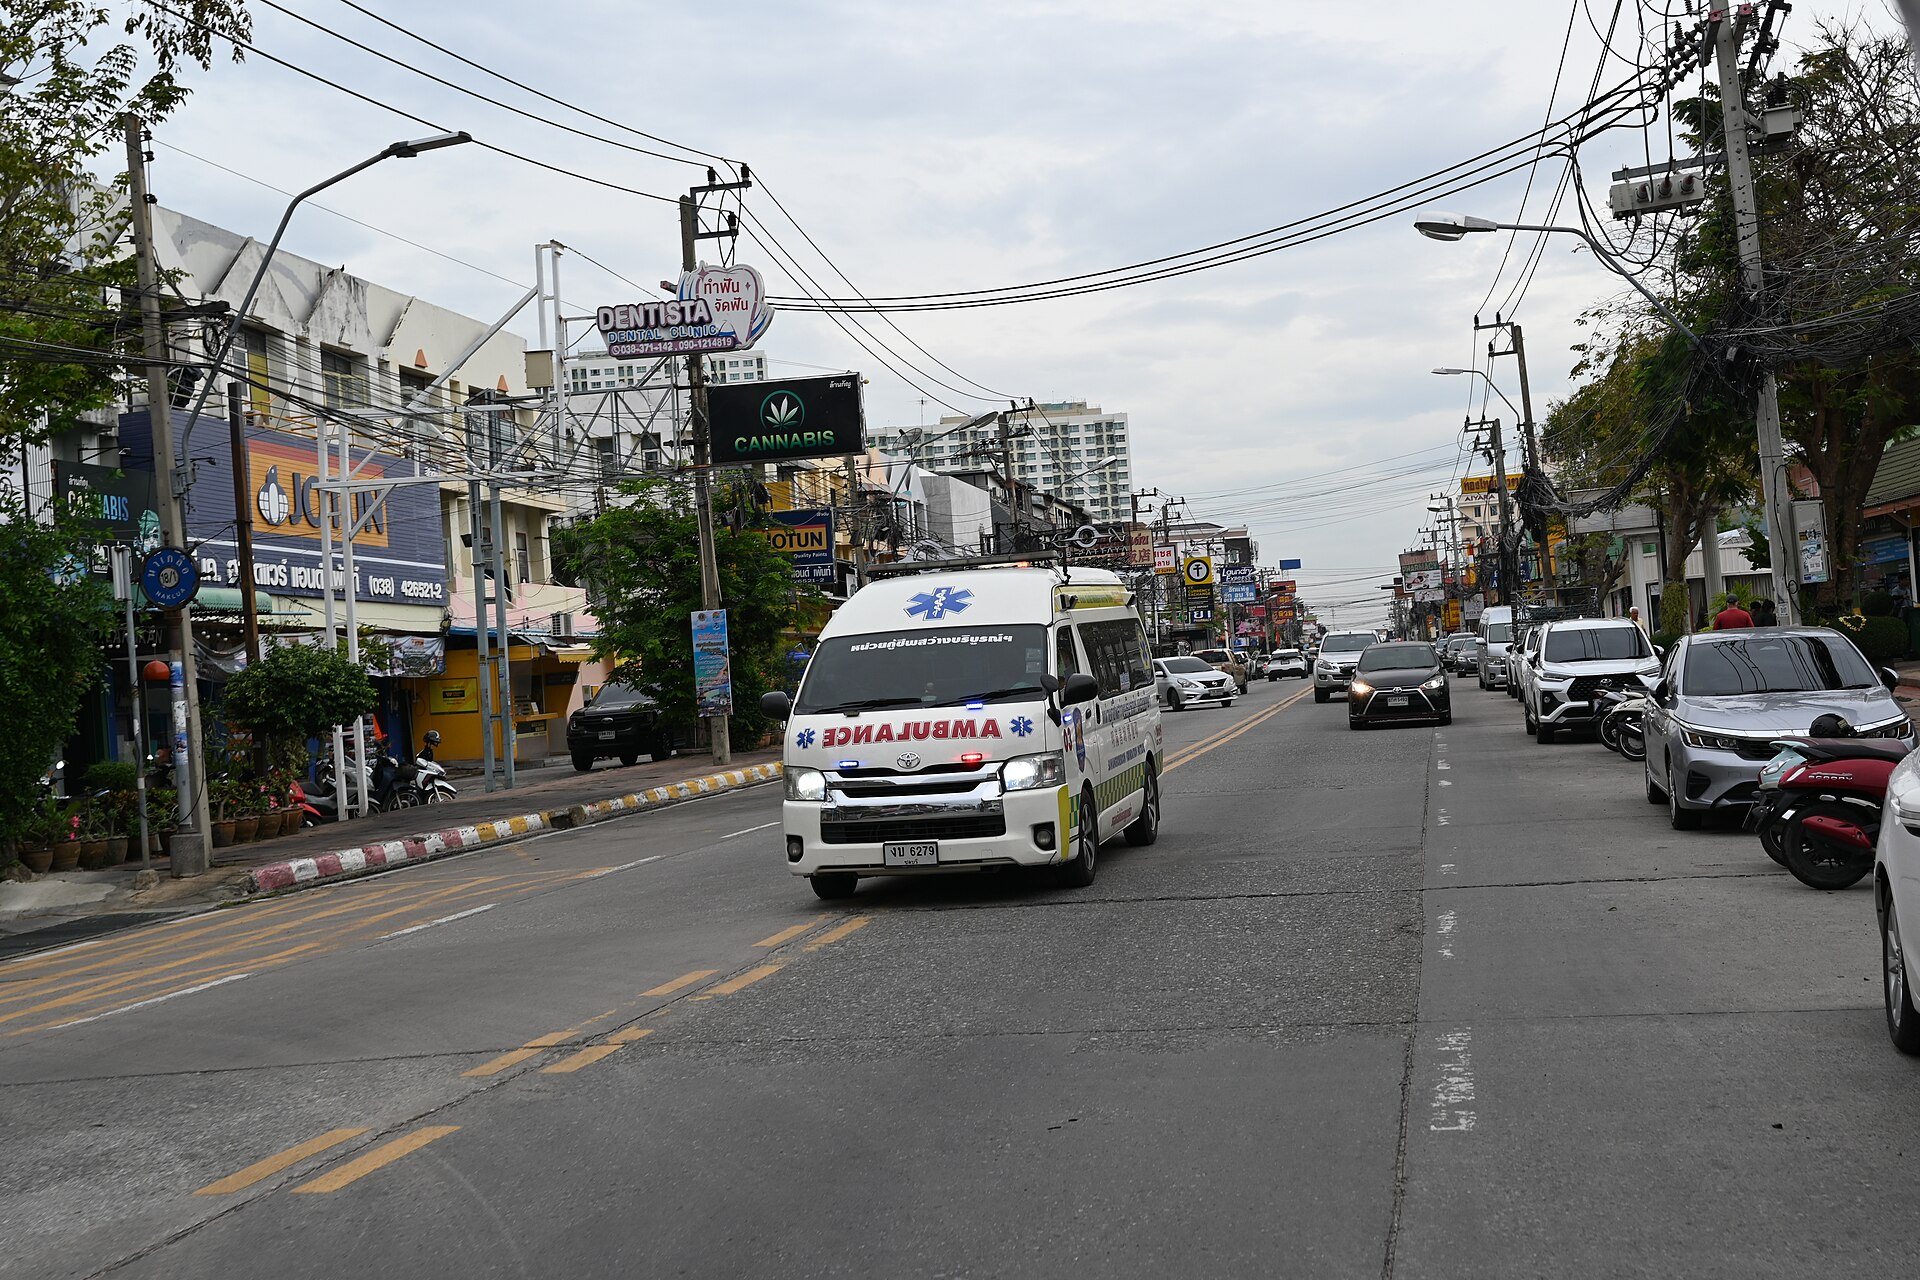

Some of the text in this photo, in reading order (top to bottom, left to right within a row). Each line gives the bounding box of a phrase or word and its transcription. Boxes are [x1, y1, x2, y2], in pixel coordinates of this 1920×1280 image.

[704, 278, 740, 294] ทำฟัน
[599, 299, 710, 331] DENTISTA
[608, 325, 718, 343] DENTAL CLINIC
[734, 430, 835, 452] CANNABIS
[1222, 567, 1253, 576] Laundry
[156, 588, 186, 600] NAKLUA
[368, 575, 395, 598] (038)
[401, 580, 443, 599] 426521-2
[1063, 727, 1073, 753] 03
[909, 846, 935, 857] 6279
